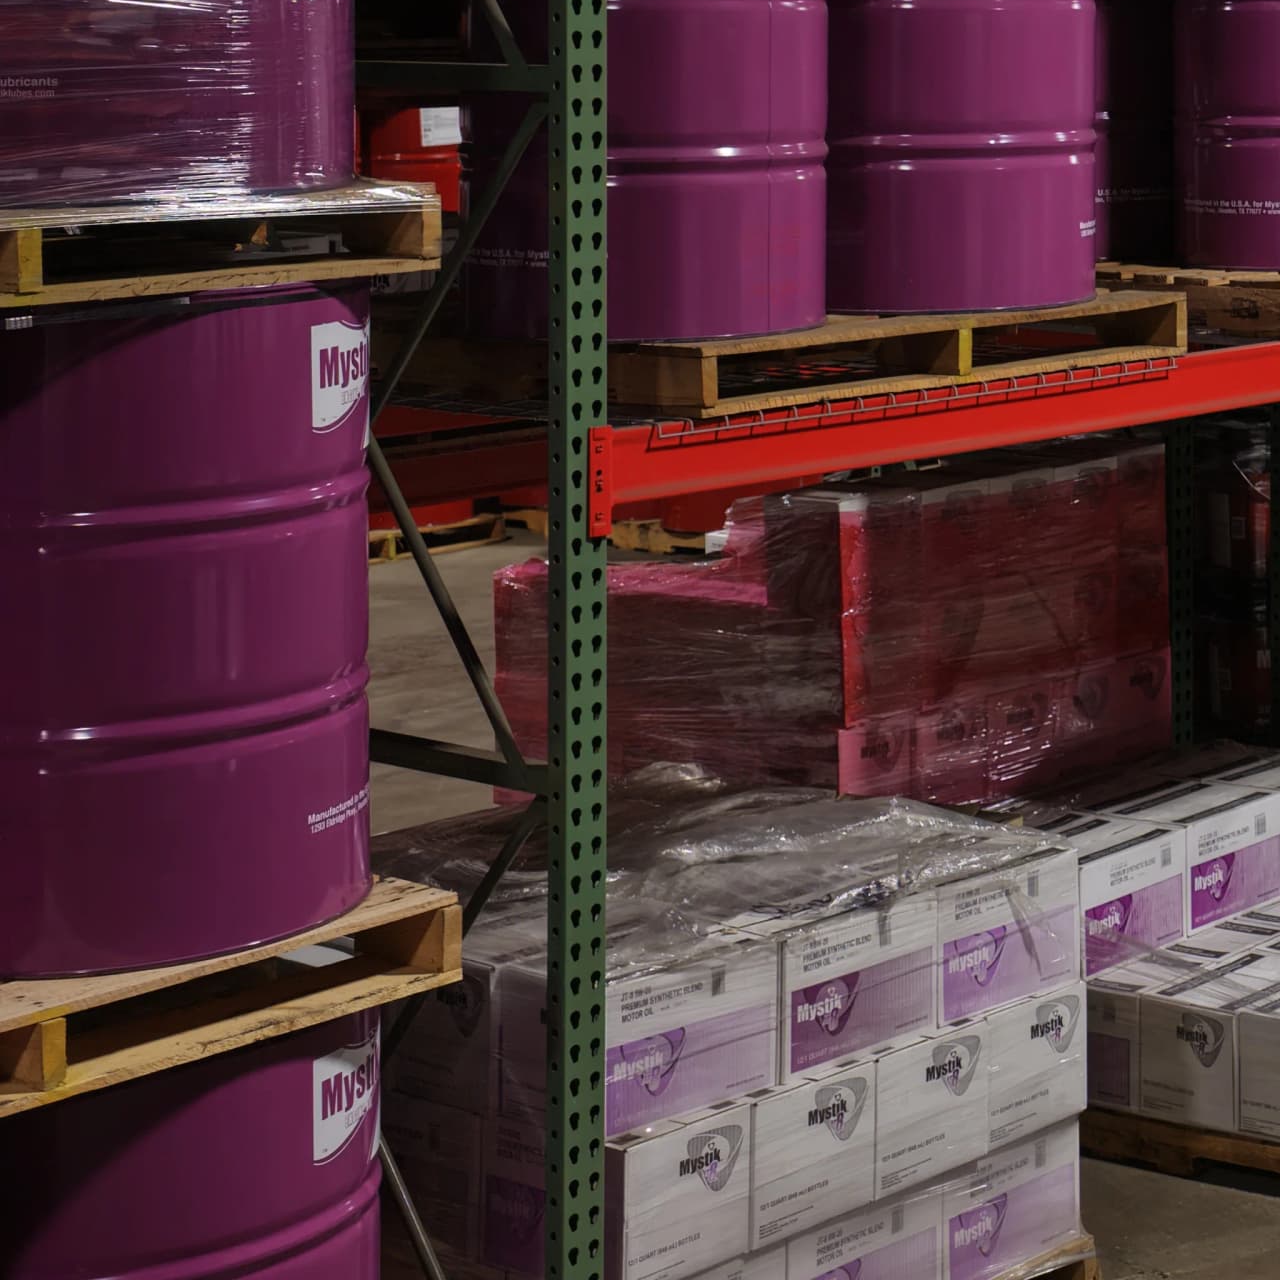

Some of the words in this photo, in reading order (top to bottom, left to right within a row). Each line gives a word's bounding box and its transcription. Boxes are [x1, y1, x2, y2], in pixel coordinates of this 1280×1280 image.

[0, 76, 58, 88] ubricants
[1231, 200, 1251, 208] U.S.A.
[1252, 200, 1263, 208] for
[308, 794, 354, 825] Manufactured
[1194, 868, 1224, 892] Mystik
[1088, 911, 1122, 936] Mystik
[948, 946, 990, 974] Mystik
[621, 999, 649, 1013] PREMIUM
[621, 1010, 643, 1023] MOTOR
[797, 993, 843, 1024] Mystik
[1030, 1015, 1064, 1040] Mystik
[925, 1056, 963, 1082] Mystik
[808, 1099, 848, 1127] Mystik
[679, 1148, 722, 1177] Mystik
[953, 1214, 994, 1249] Mystik
